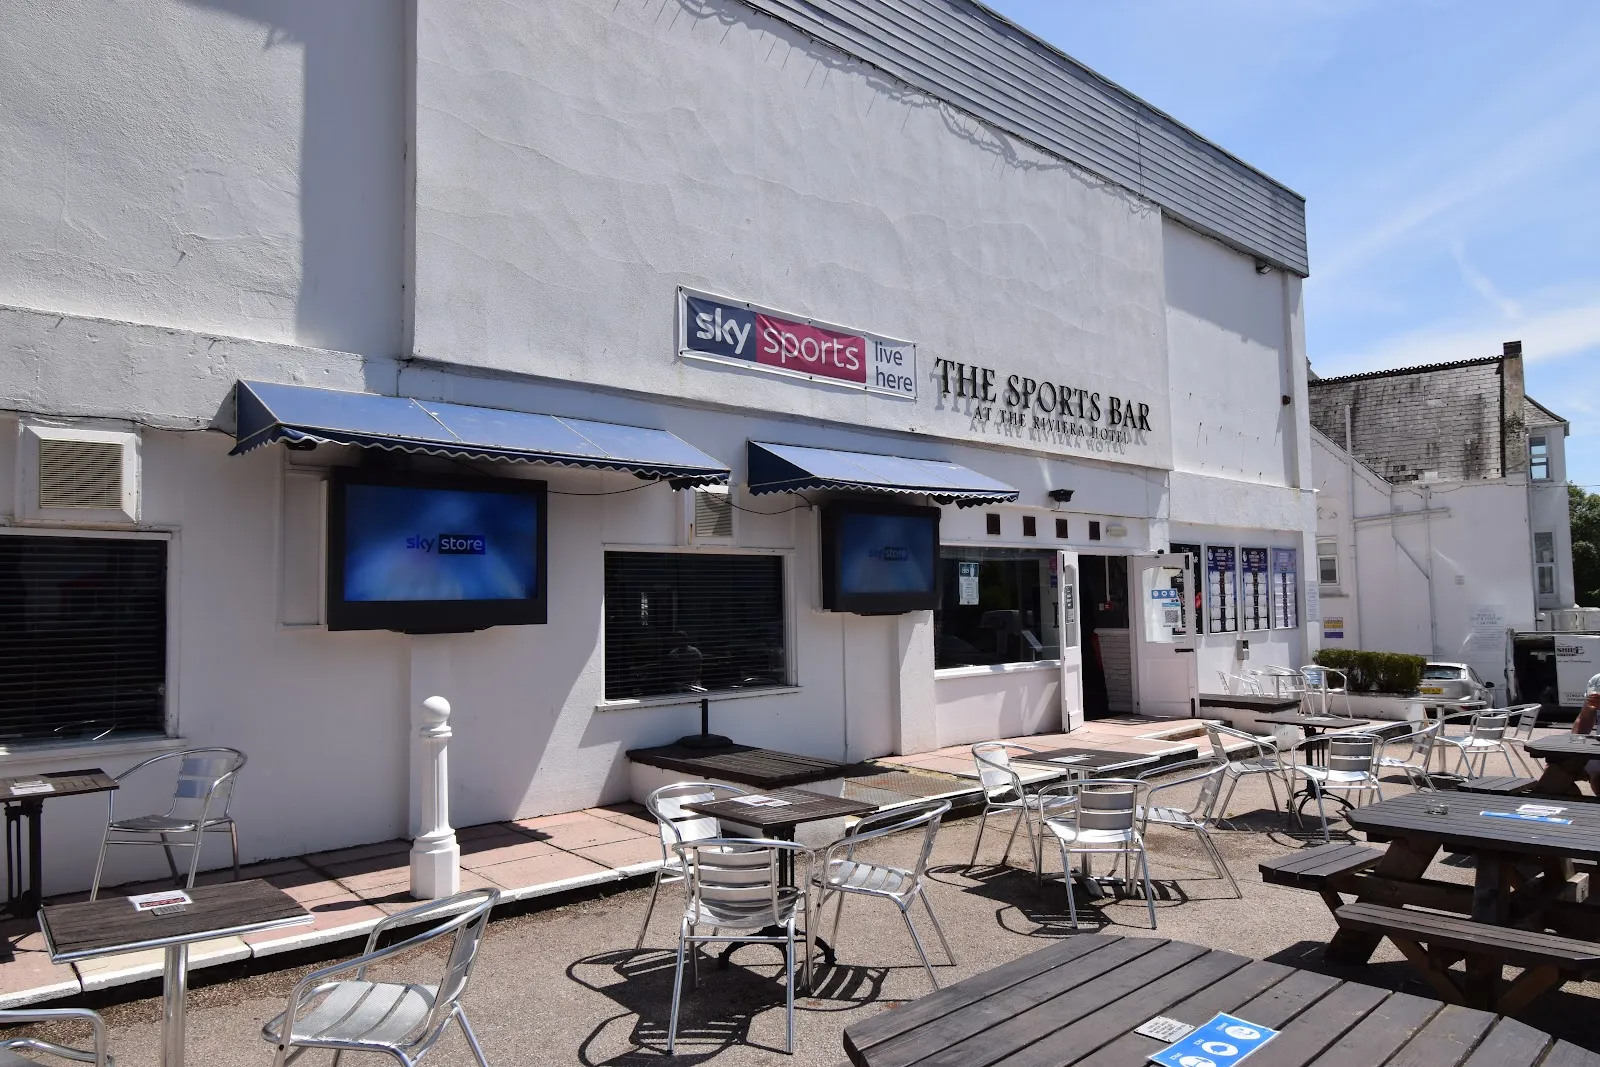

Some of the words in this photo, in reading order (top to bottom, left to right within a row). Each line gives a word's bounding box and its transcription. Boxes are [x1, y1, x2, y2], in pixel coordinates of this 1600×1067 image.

[696, 307, 751, 355] sky
[763, 327, 860, 371] sports
[875, 341, 903, 366] live
[876, 366, 913, 392] here
[936, 356, 997, 404] THE
[1006, 374, 1101, 422] SPORTS
[1109, 396, 1152, 432] BAR
[973, 405, 993, 421] AT
[999, 409, 1027, 428] THE
[1033, 416, 1087, 437] RIVIERA
[1091, 426, 1130, 445] HOTEL
[406, 534, 436, 553] sky
[441, 537, 483, 551] store
